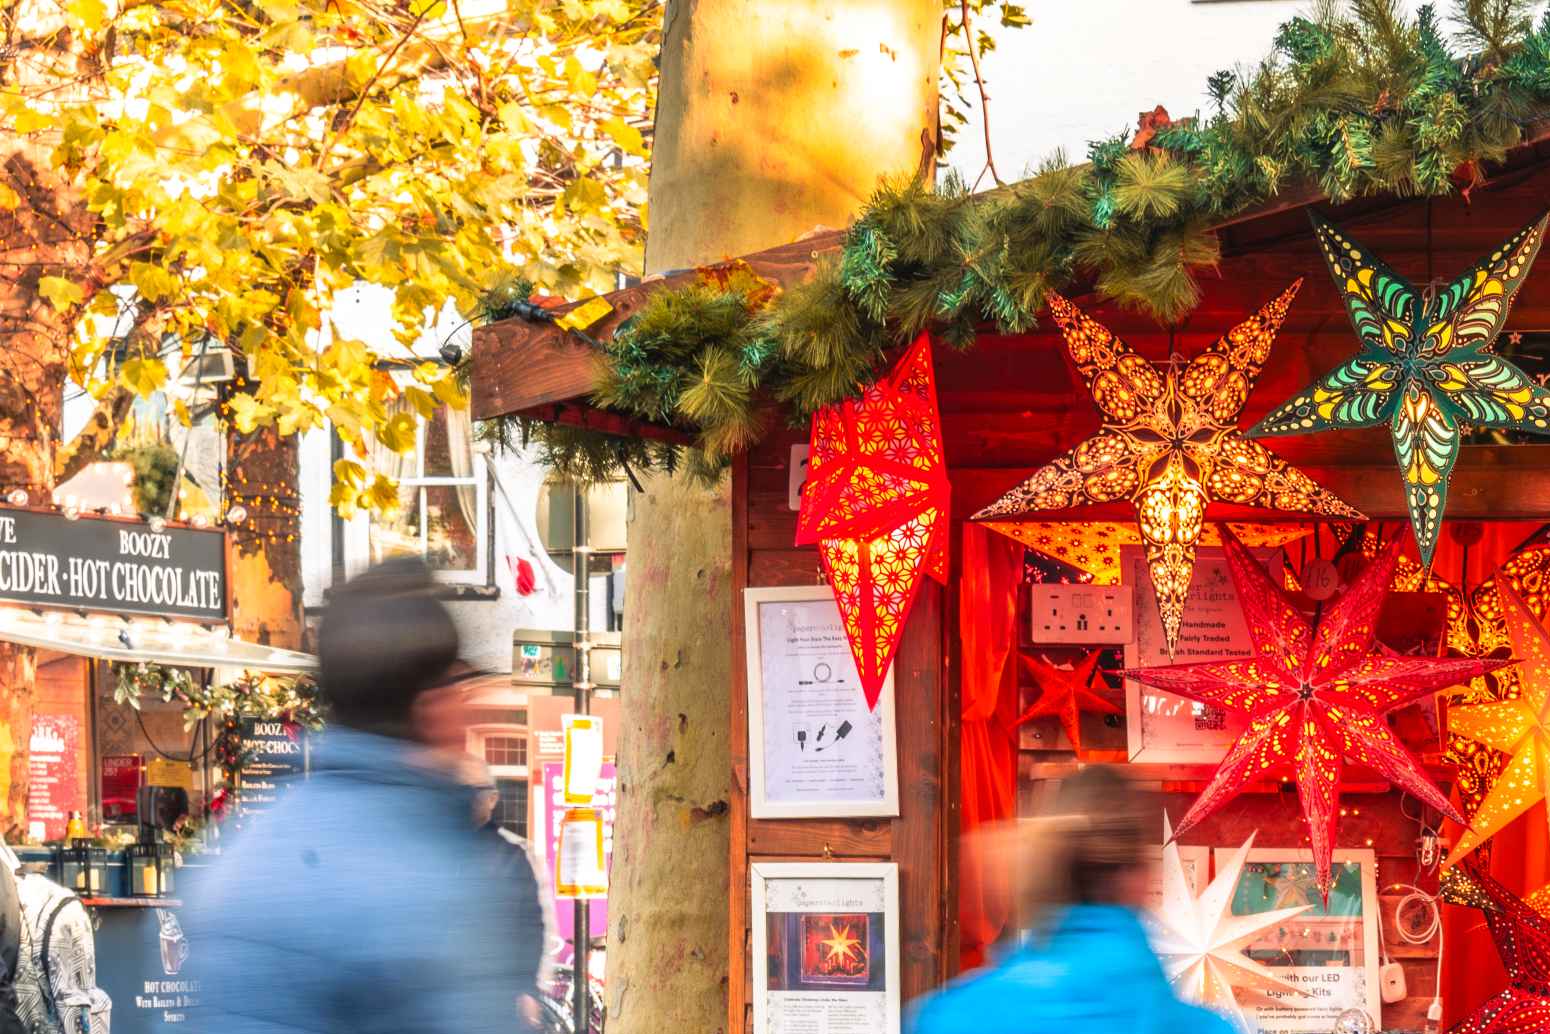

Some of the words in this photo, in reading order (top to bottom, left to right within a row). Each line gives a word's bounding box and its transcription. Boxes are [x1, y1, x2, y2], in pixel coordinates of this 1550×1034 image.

[119, 530, 172, 559] BOOZY
[0, 551, 62, 595] CIDER
[69, 557, 110, 599] HOT
[112, 562, 221, 609] CHOCOLATE
[1160, 648, 1185, 656] Brsh
[1302, 975, 1320, 983] our
[1322, 973, 1340, 982] LED
